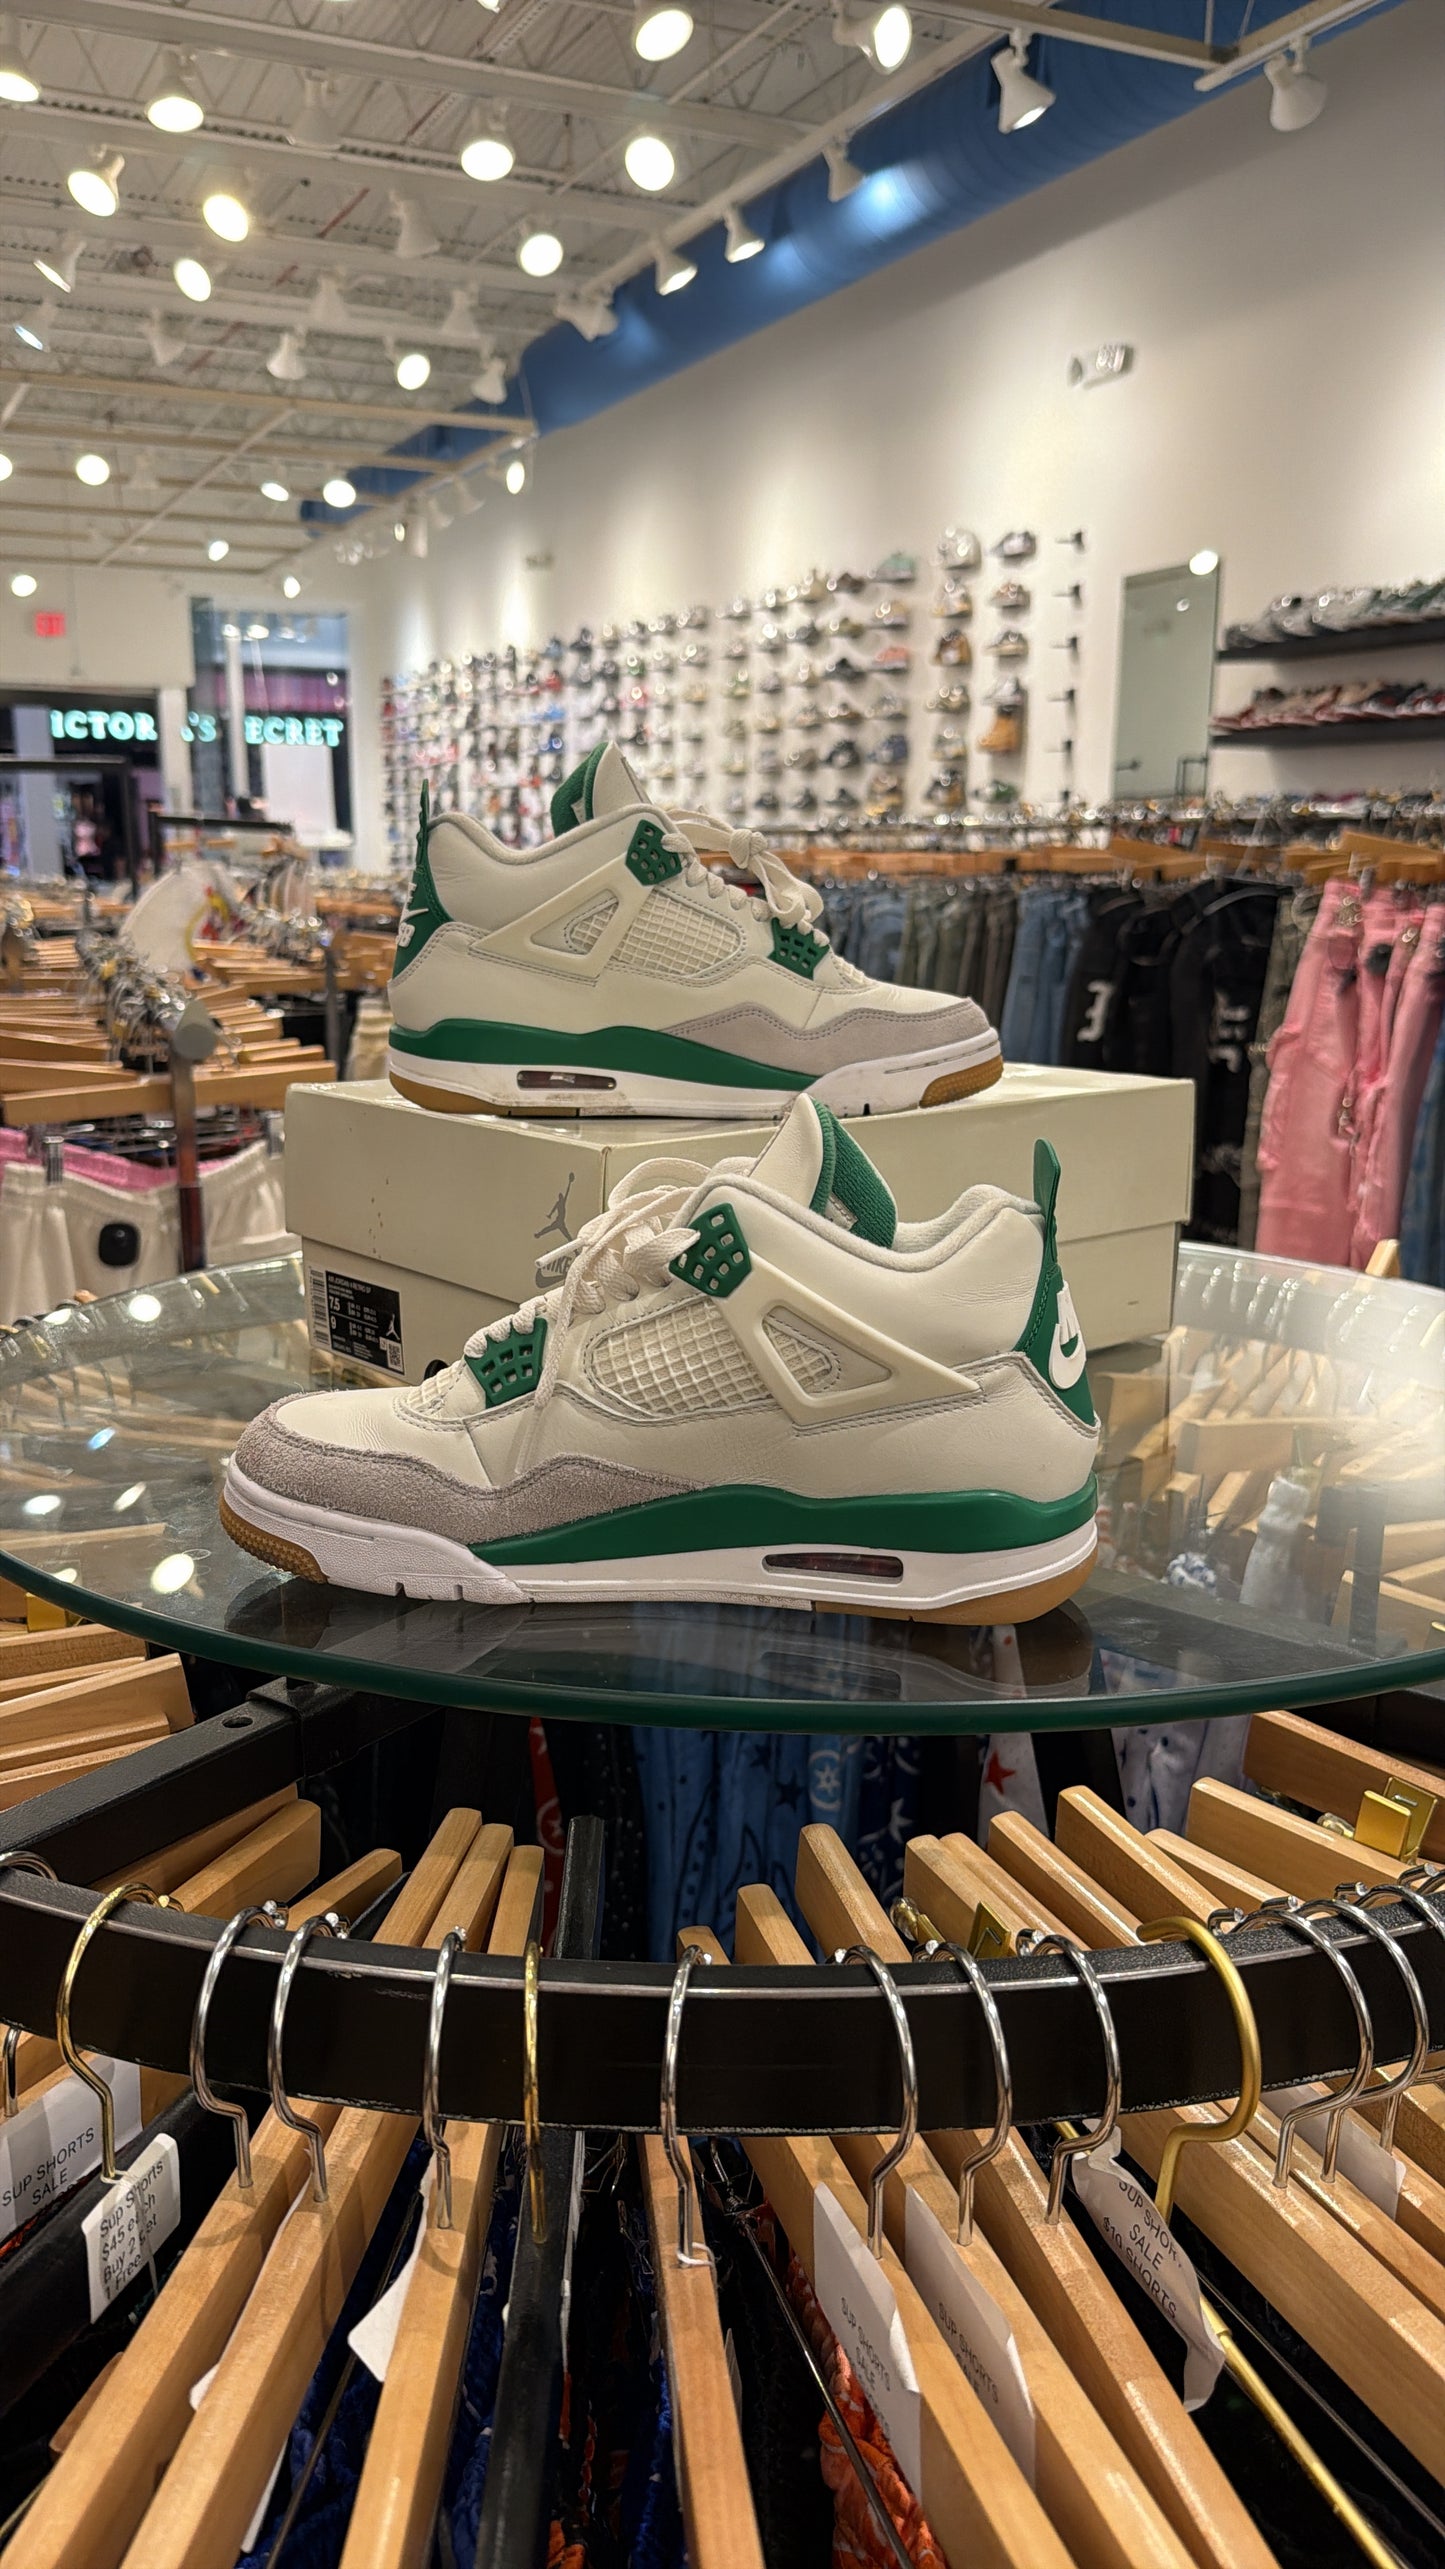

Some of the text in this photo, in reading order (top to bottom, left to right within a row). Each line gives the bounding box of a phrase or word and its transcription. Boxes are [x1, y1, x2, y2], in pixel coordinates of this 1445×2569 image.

[244, 715, 345, 747] ECRET
[328, 1296, 341, 1311] 7.5
[330, 1315, 337, 1330] 9
[2, 2174, 33, 2207] SUP
[36, 2127, 95, 2181] SHORTS
[32, 2167, 68, 2206] SALE
[1118, 2180, 1144, 2209] SUP
[100, 2206, 124, 2238] Sup
[102, 2225, 125, 2262] $45
[103, 2252, 126, 2285] Buy
[128, 2237, 136, 2255] 2
[1129, 2223, 1164, 2271] SALE
[115, 2253, 142, 2291] Free
[1103, 2215, 1177, 2320] $10 SHORTS
[840, 2296, 857, 2329] SUP
[857, 2325, 891, 2392] SHORTS
[938, 2302, 999, 2404] SUP SHORTS
